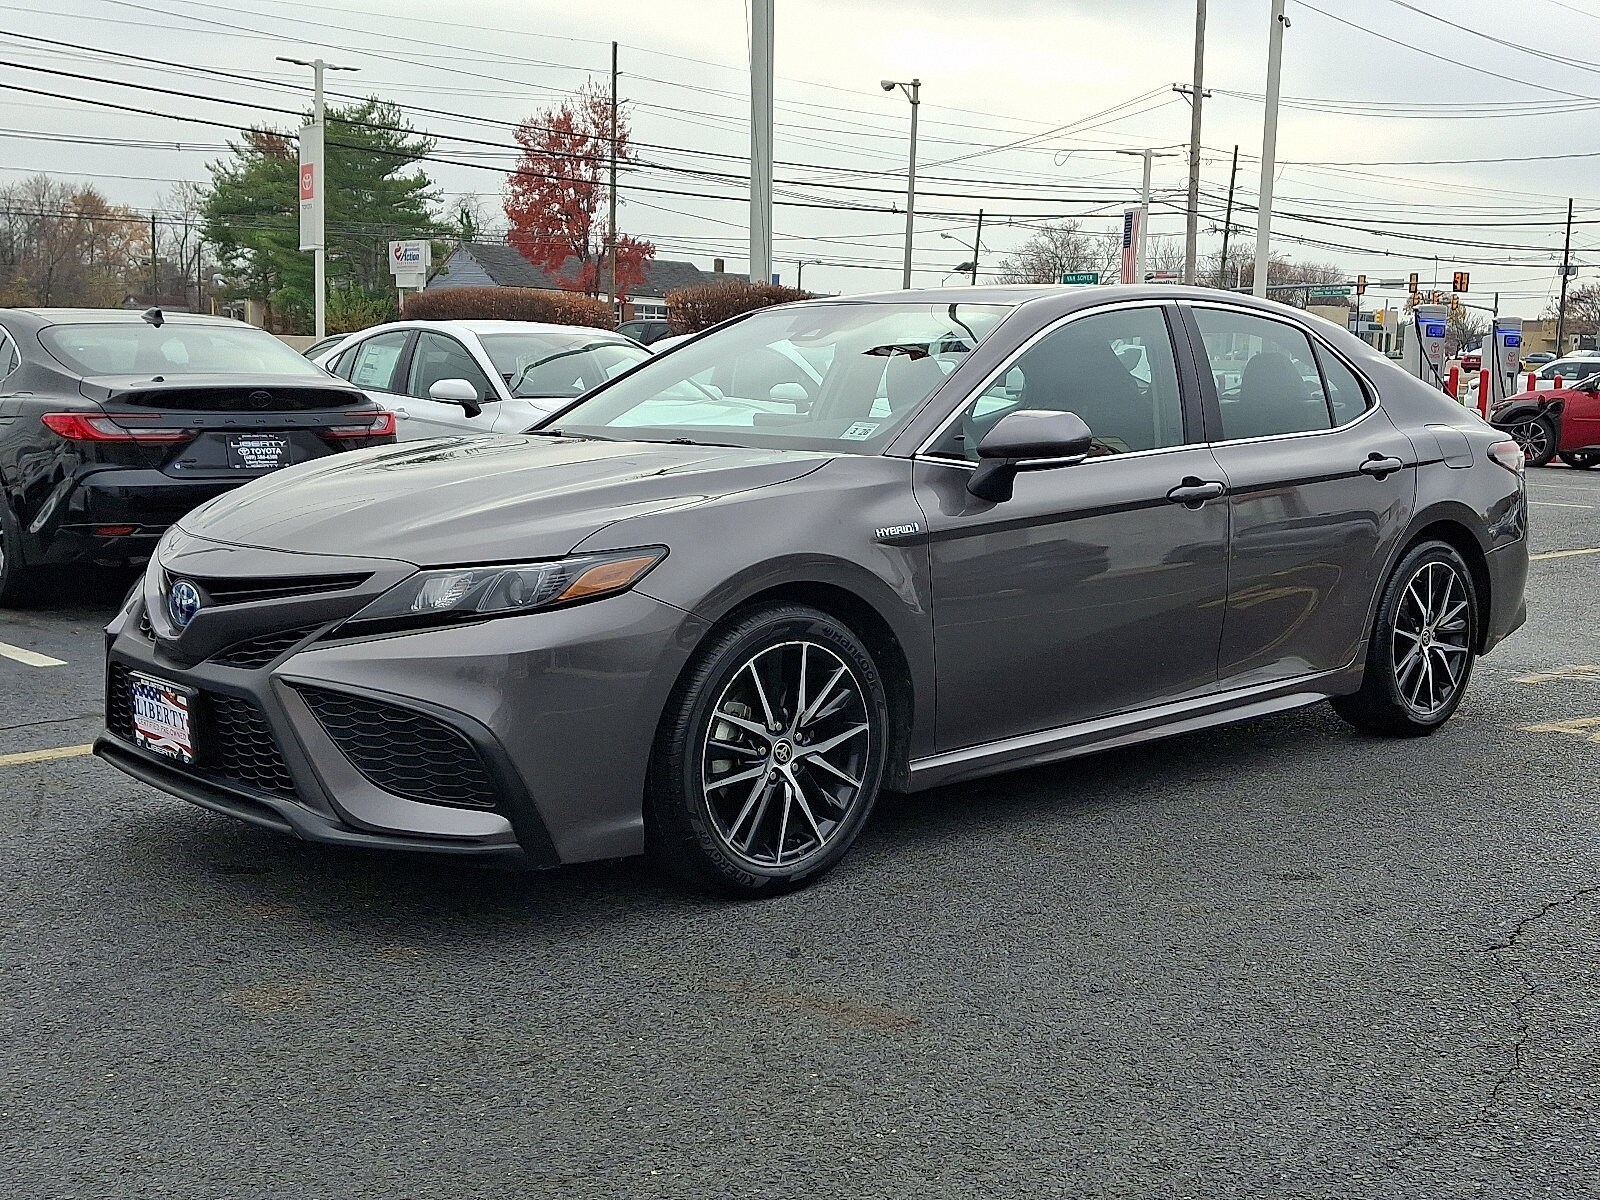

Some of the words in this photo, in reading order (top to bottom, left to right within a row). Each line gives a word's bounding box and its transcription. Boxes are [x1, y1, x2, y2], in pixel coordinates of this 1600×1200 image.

[875, 522, 914, 538] HYBRID
[135, 697, 186, 730] LIBERTY
[137, 718, 160, 732] CERTIFIED
[145, 741, 179, 759] LIBERTY
